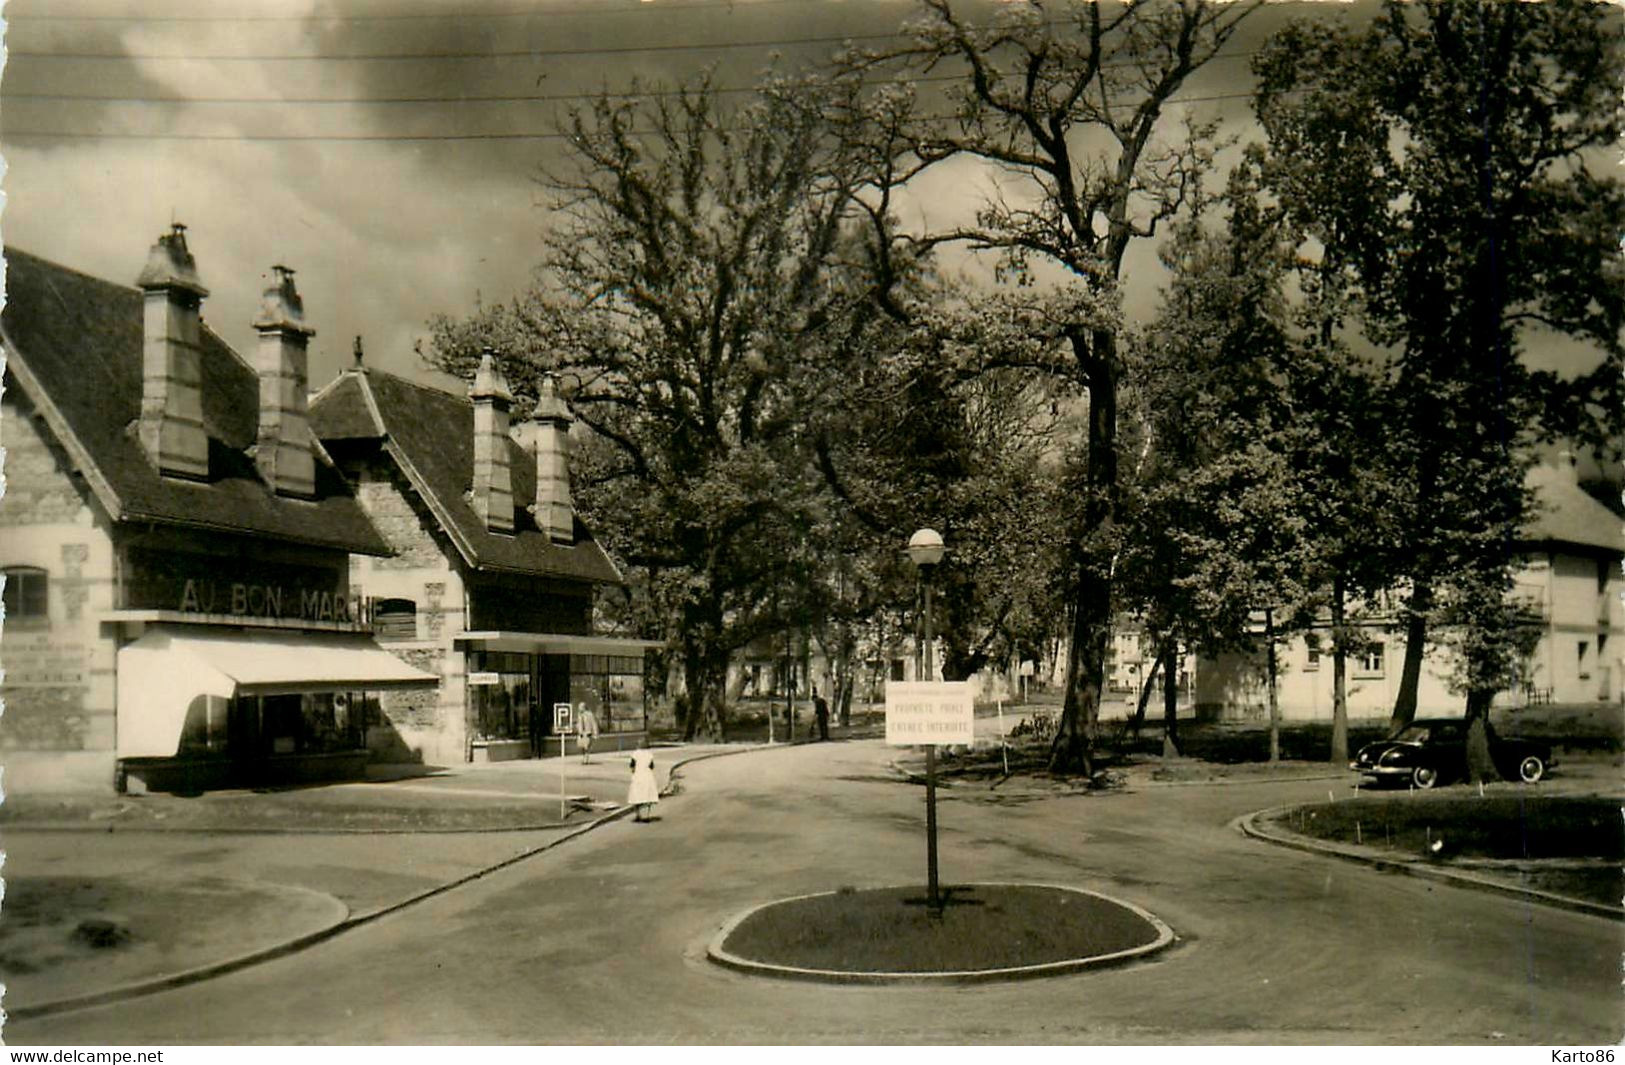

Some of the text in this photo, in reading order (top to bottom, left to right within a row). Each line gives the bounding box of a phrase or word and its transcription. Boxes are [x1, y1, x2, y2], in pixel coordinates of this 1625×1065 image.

[181, 578, 217, 613] AU
[232, 583, 282, 616] BON
[558, 708, 569, 727] P
